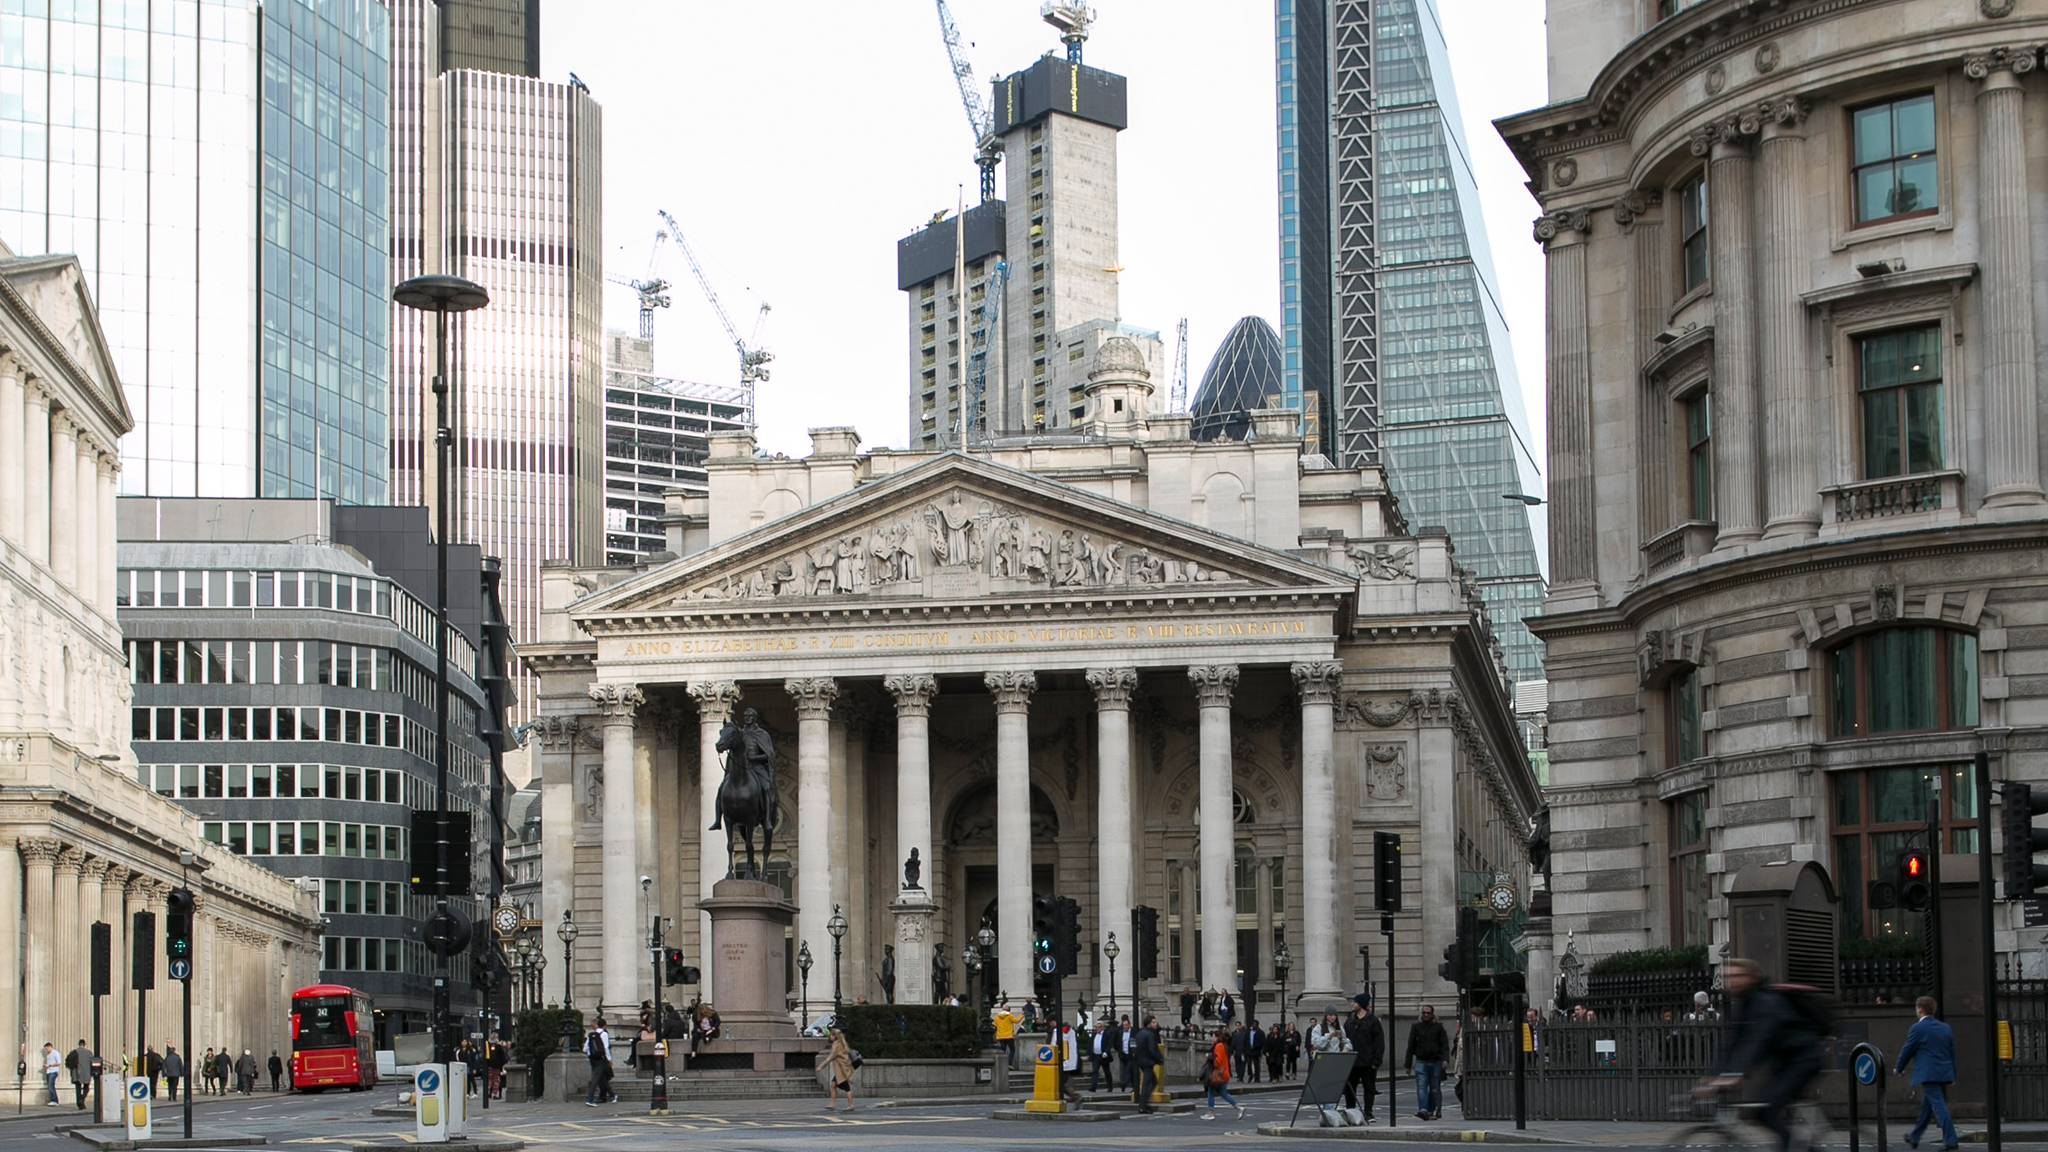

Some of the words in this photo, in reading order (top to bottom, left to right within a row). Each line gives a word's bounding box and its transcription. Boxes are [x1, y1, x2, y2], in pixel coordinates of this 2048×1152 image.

[625, 642, 671, 656] ANNO
[682, 638, 798, 654] ELIZABETHAE
[808, 636, 820, 649] R
[969, 629, 1018, 645] ANNO
[1028, 625, 1116, 643] VICTORIAE
[1127, 625, 1137, 639] R
[317, 1008, 328, 1016] 242
